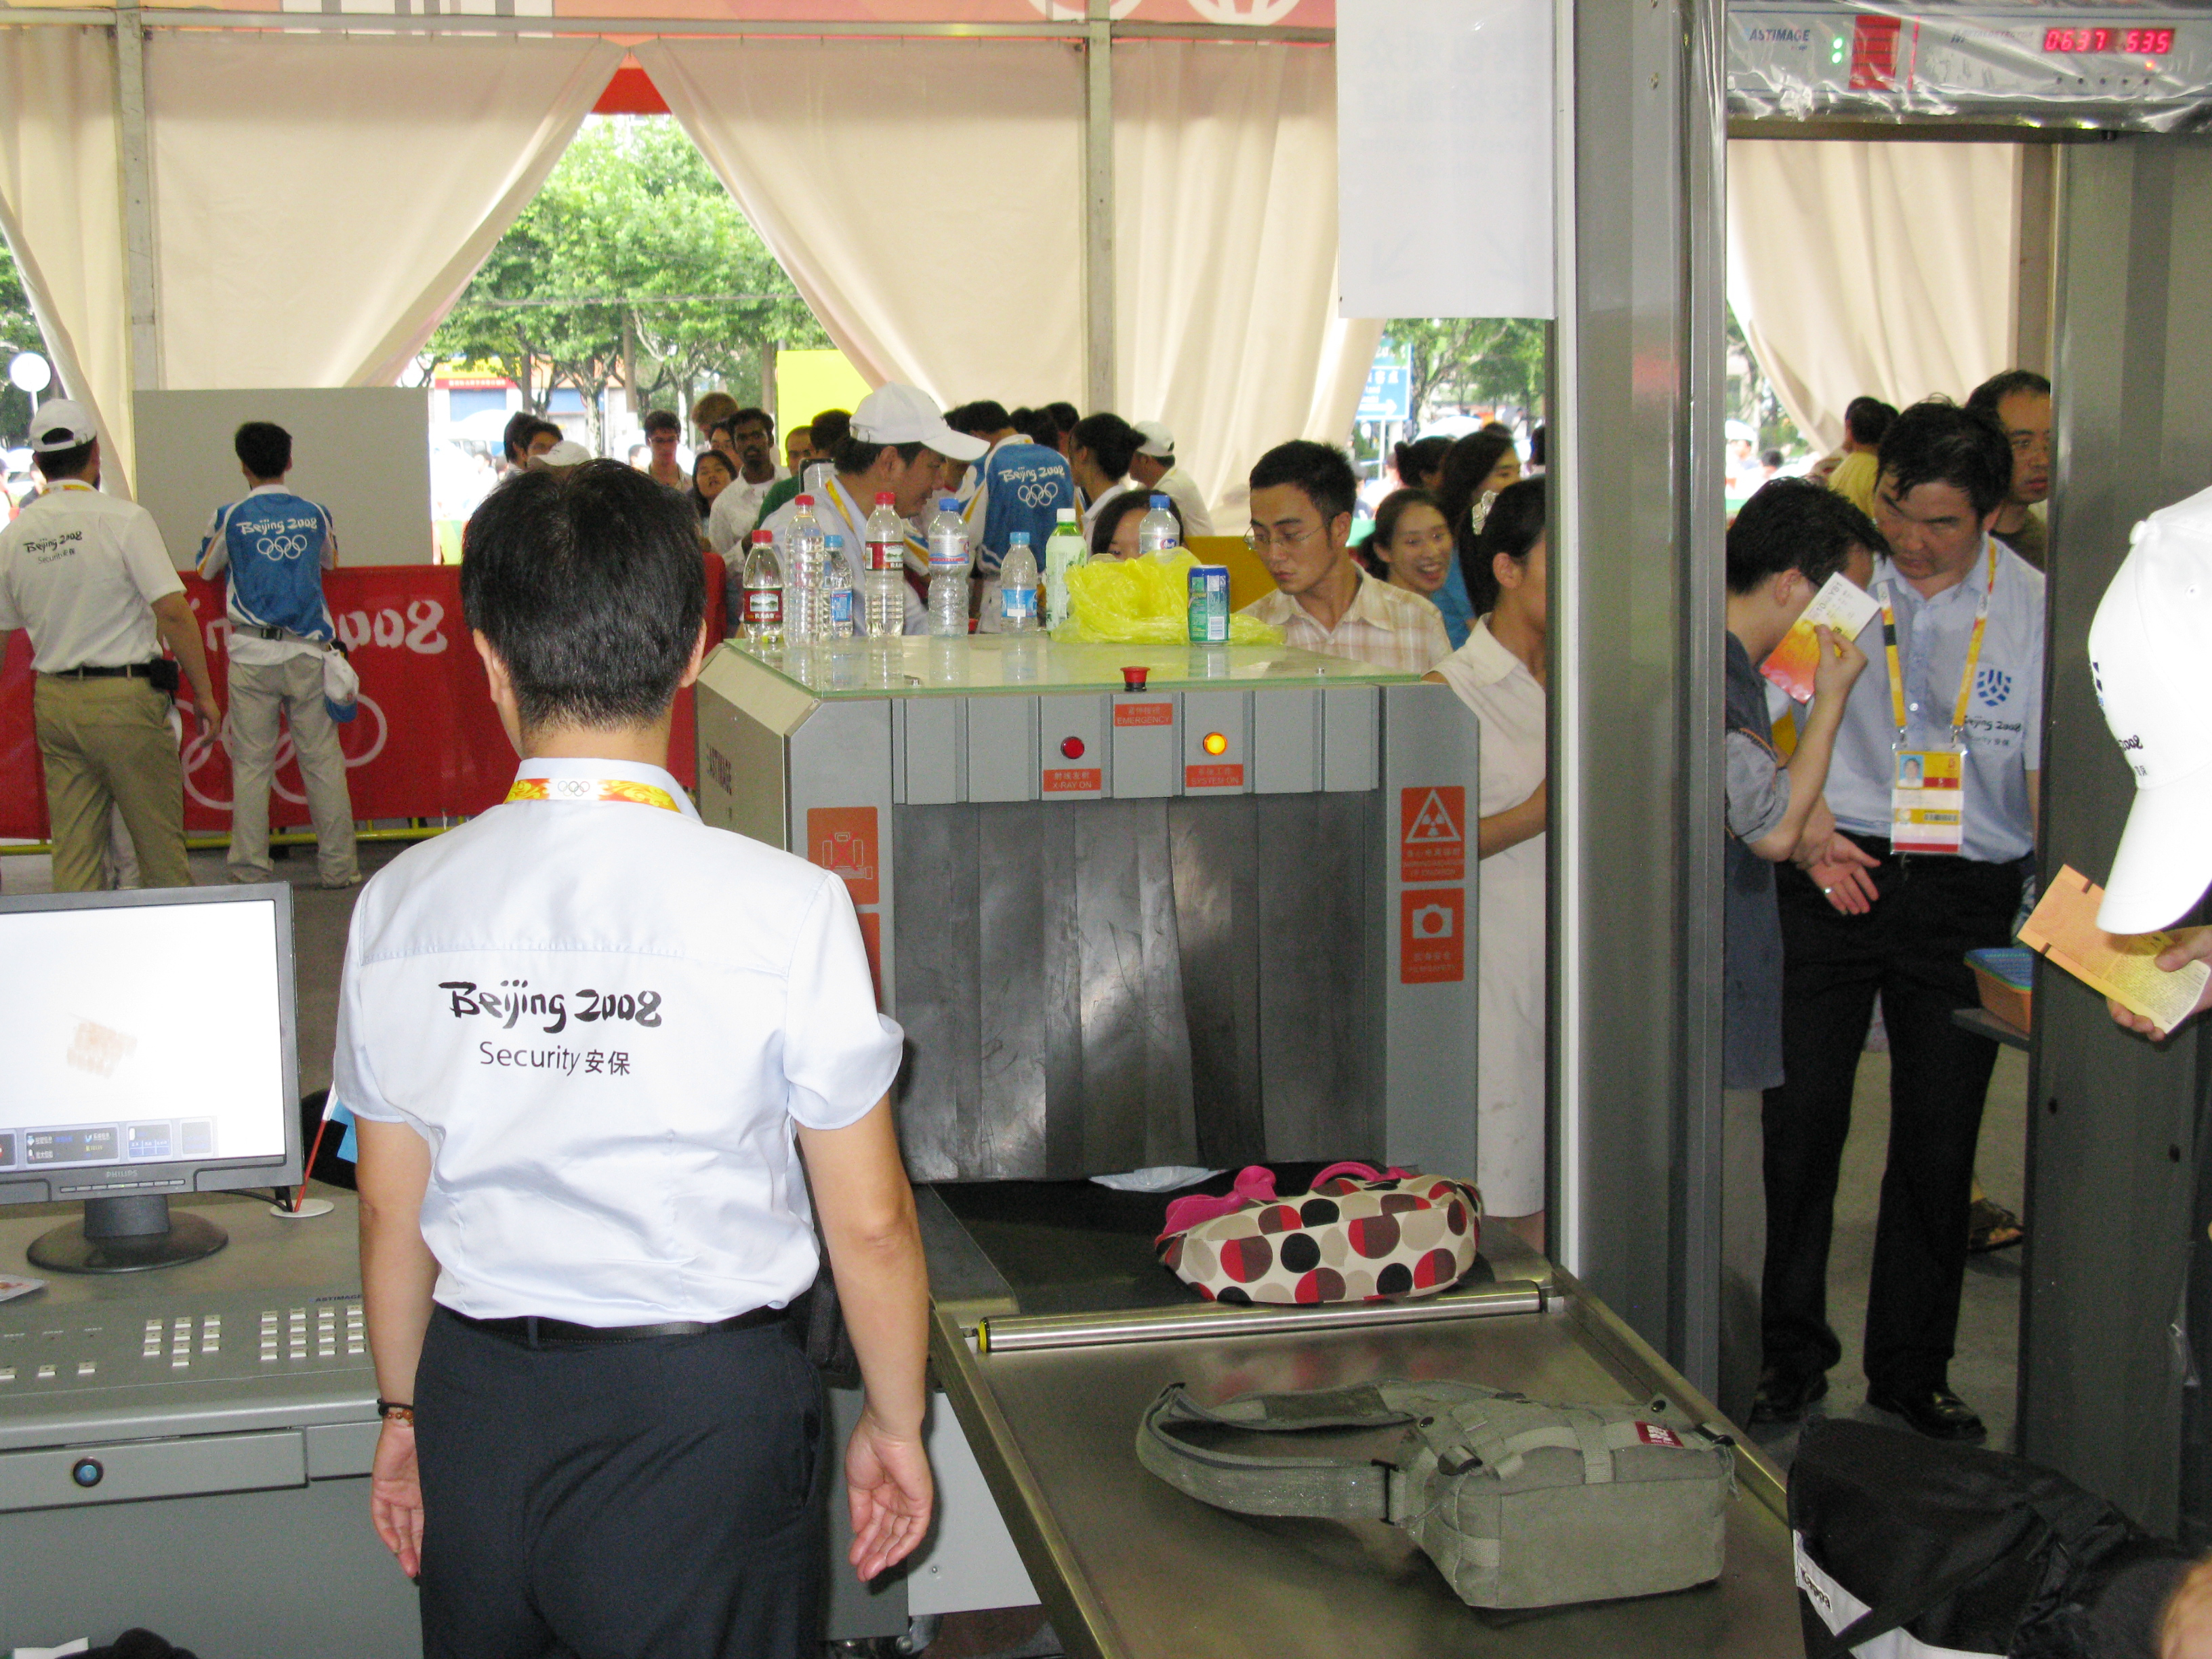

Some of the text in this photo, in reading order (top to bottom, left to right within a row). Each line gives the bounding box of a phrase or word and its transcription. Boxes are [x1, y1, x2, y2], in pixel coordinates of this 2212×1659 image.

[2044, 29, 2170, 54] 0637 535
[998, 465, 1065, 483] Beijing 2008
[236, 517, 318, 535] Beijing 2008
[22, 531, 83, 553] Beijing 2008
[338, 600, 449, 654] 008
[1117, 715, 1170, 725] EMERGENCY
[1053, 781, 1092, 790] X-RAY ON
[1191, 776, 1240, 785] SYSTEM ON
[438, 979, 662, 1034] Beijing 2008
[479, 1041, 631, 1077] Security 安保
[106, 1170, 138, 1179] PHILIPS
